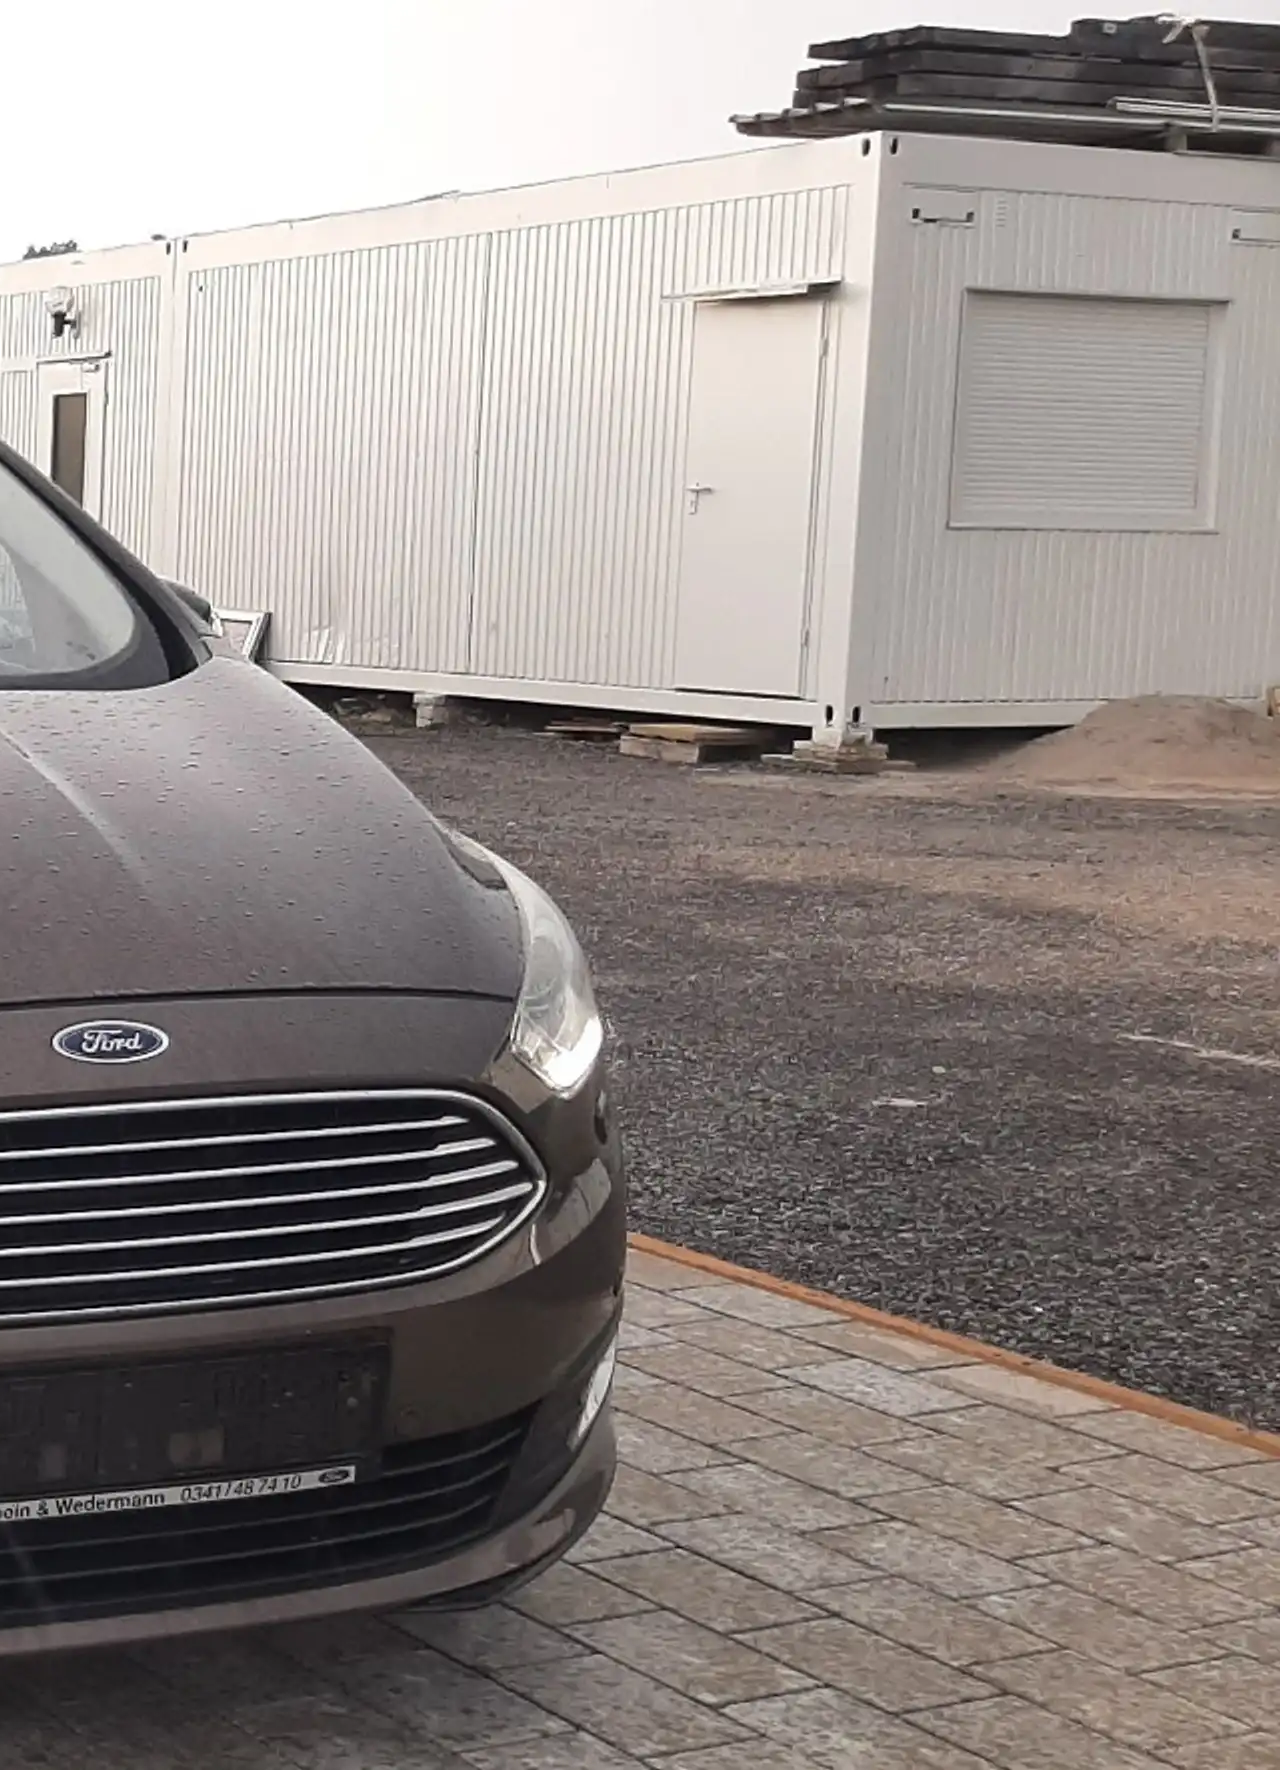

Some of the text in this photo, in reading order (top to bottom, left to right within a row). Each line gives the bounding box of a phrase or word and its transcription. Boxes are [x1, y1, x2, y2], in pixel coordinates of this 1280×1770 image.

[81, 1029, 143, 1053] Ford
[36, 1499, 49, 1516] &
[54, 1492, 165, 1514] Wedermann
